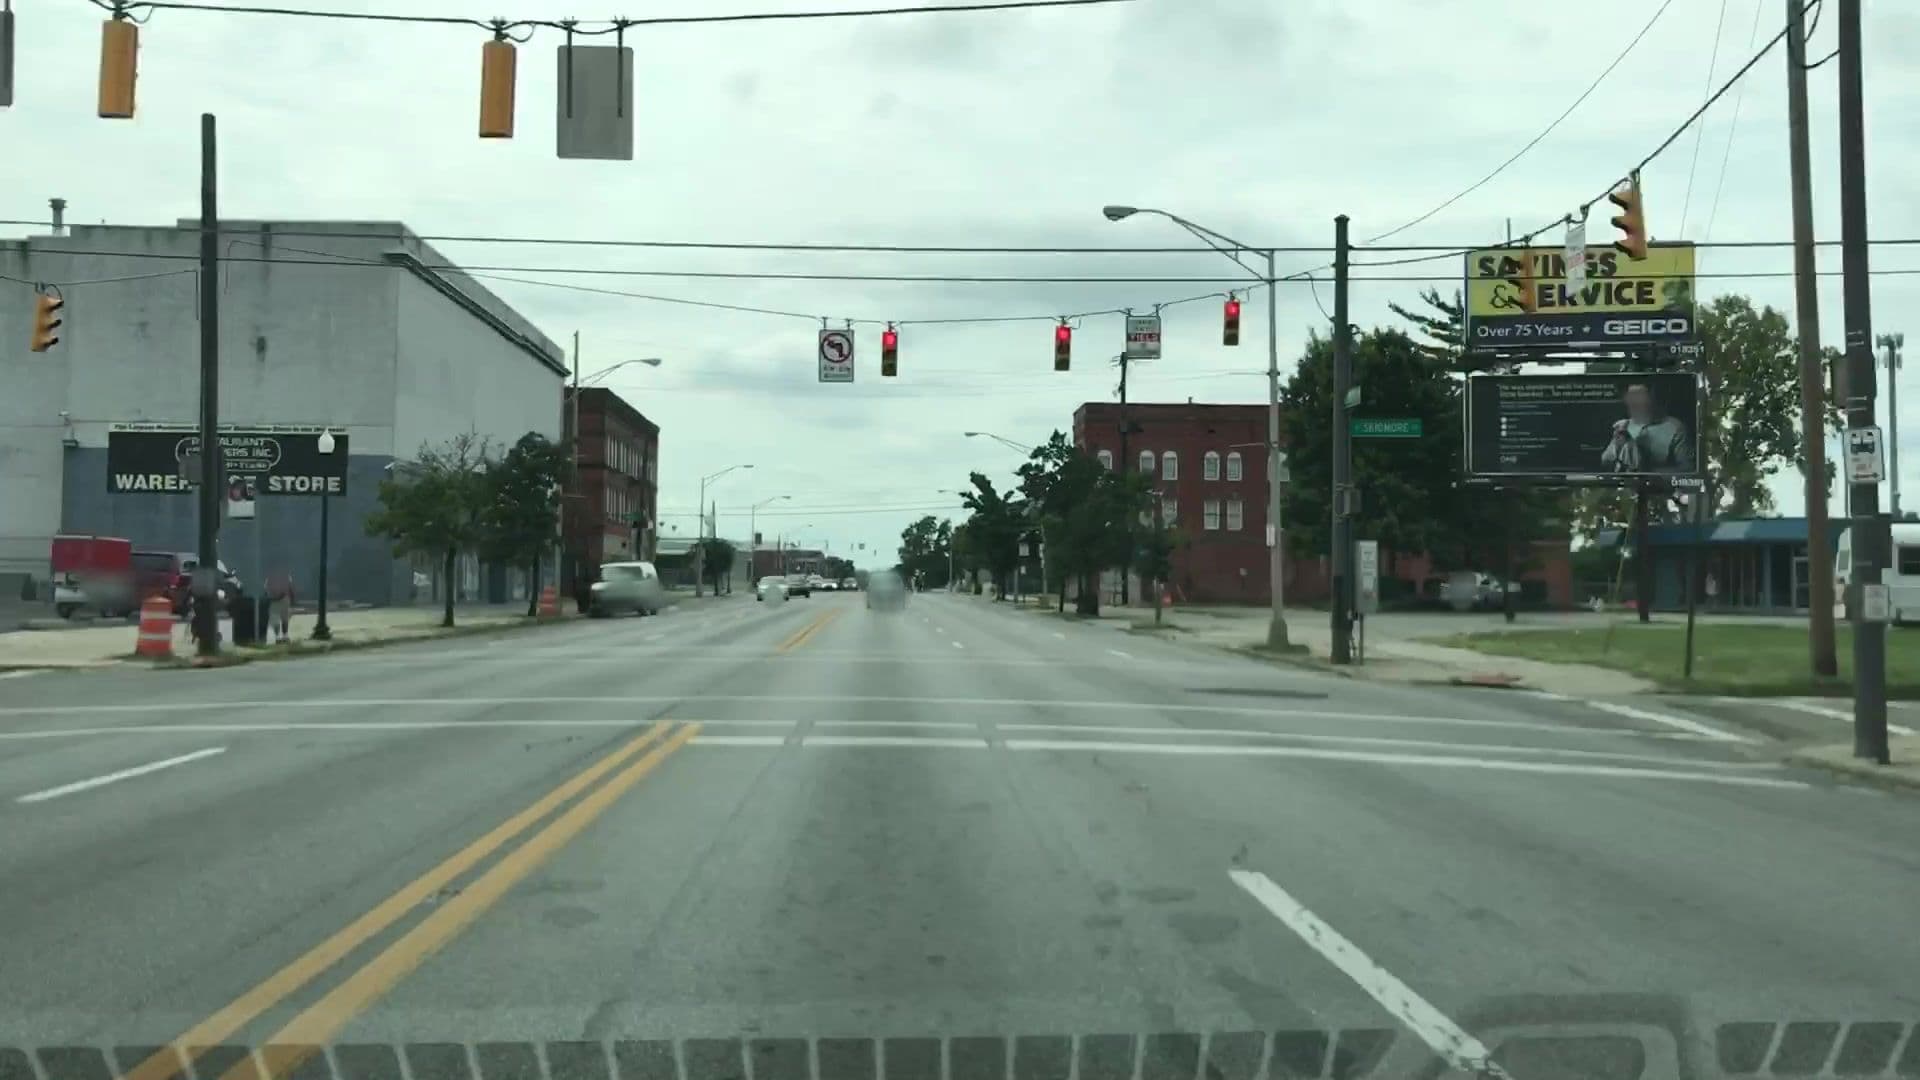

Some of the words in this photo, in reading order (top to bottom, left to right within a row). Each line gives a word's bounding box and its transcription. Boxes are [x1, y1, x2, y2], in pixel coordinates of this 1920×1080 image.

[1478, 252, 1617, 277] SAINGS
[1537, 280, 1656, 307] ERVICE
[1477, 326, 1511, 337] Over
[1515, 324, 1532, 336] 75
[1536, 324, 1574, 336] Years
[1604, 318, 1689, 335] GEICO
[268, 475, 341, 492] STORE
